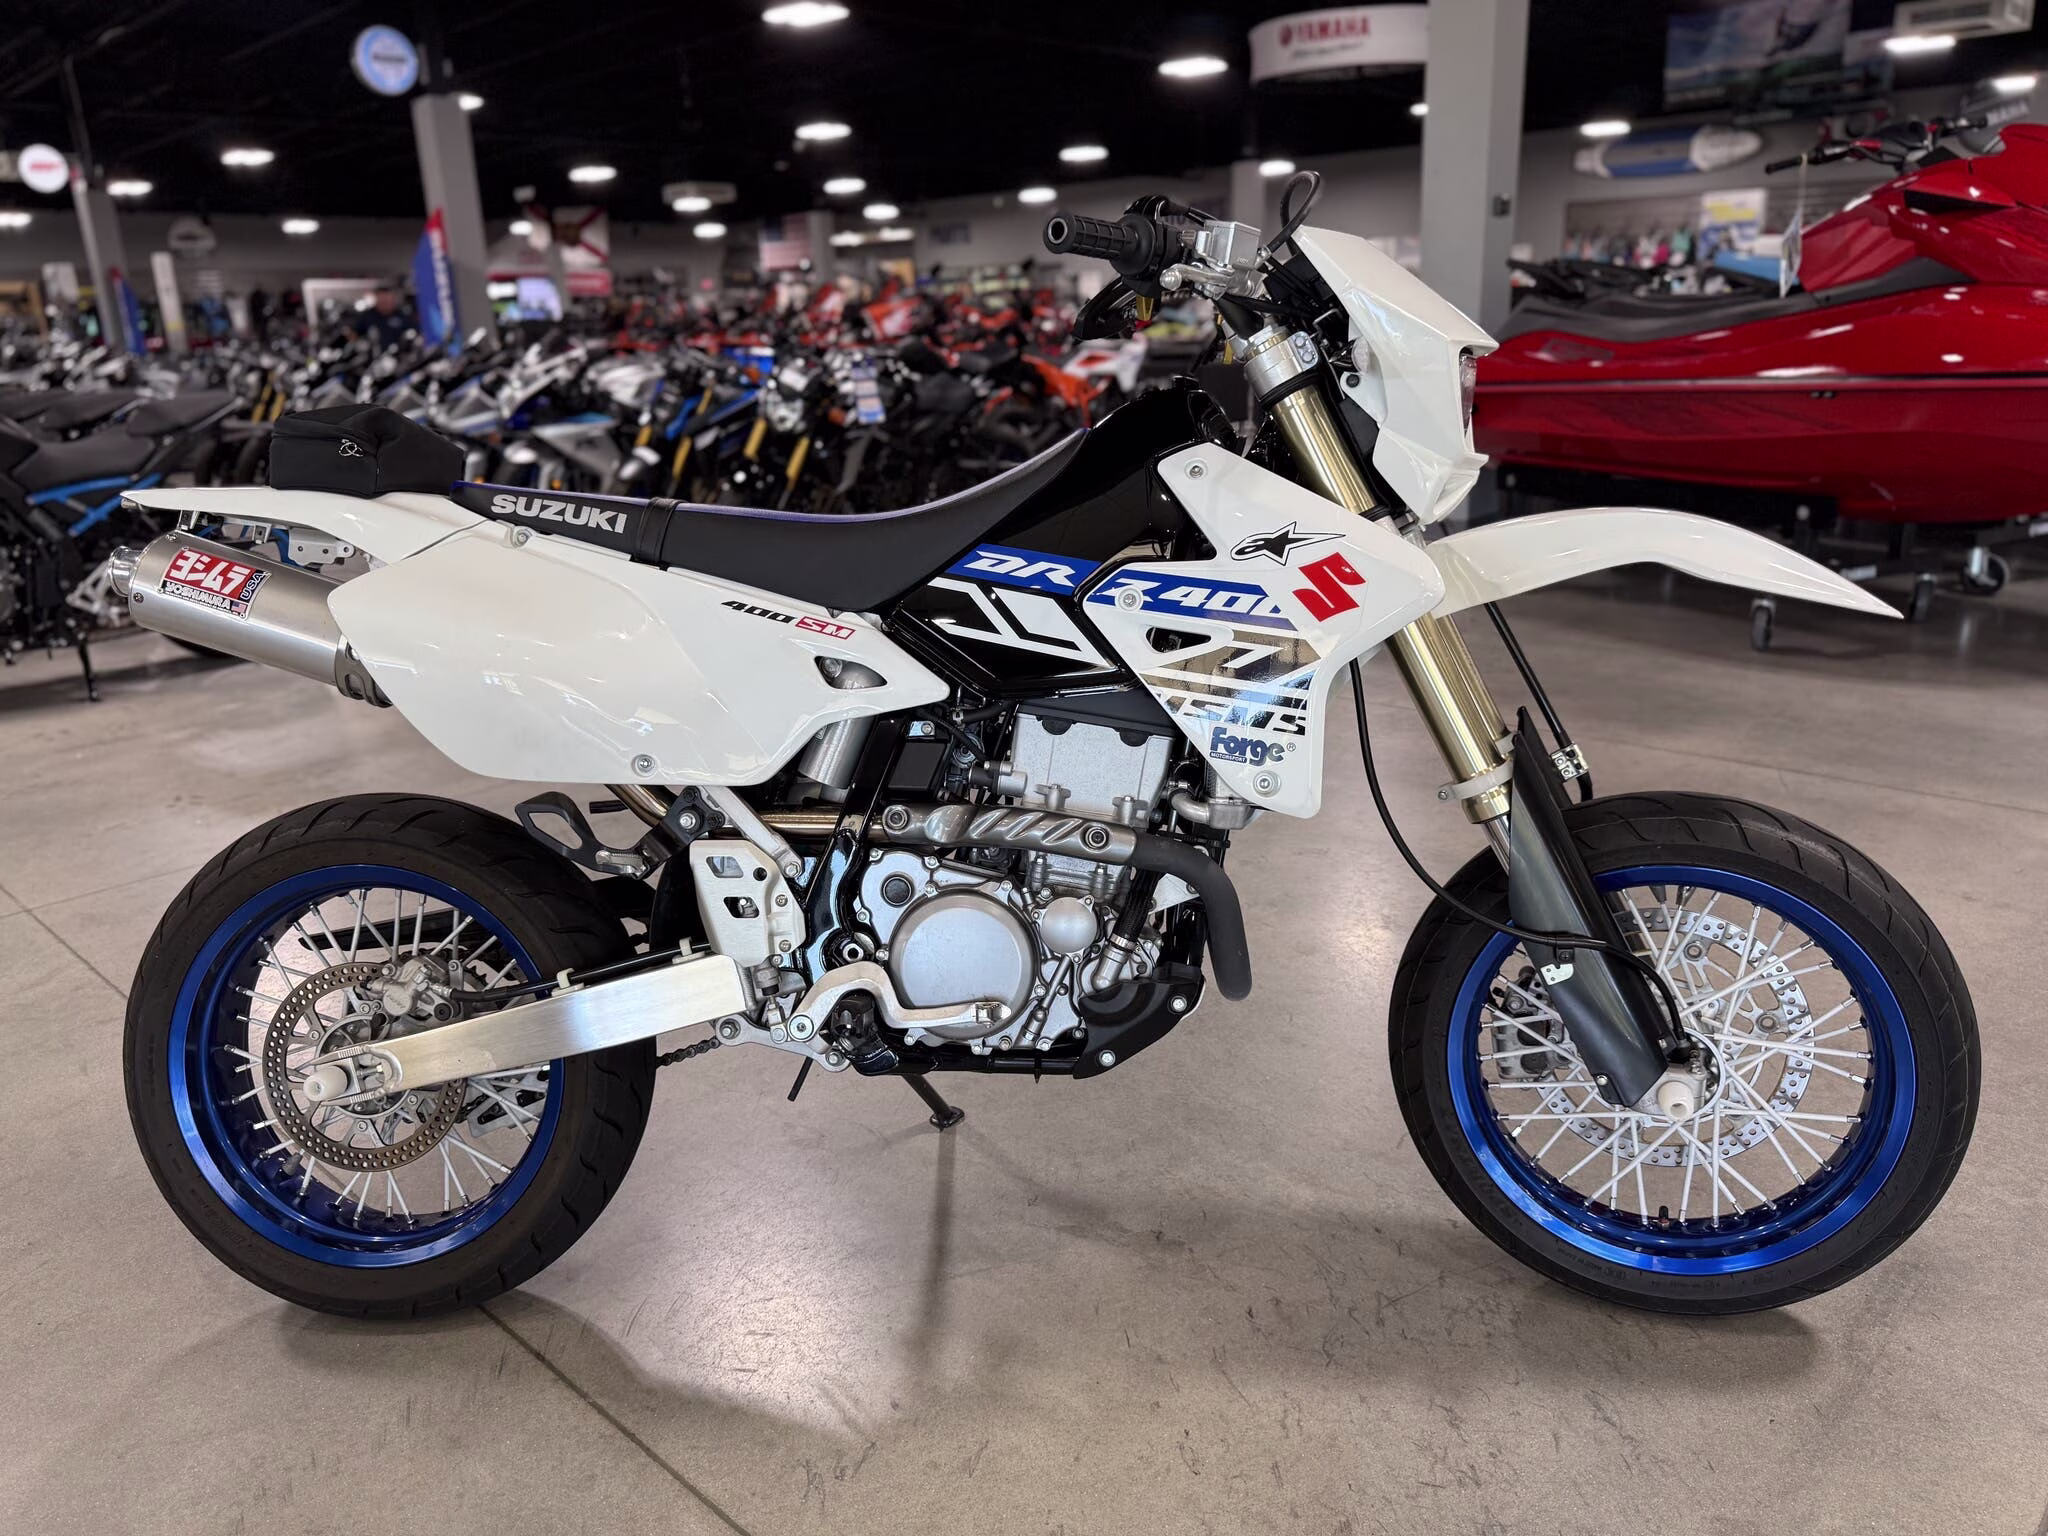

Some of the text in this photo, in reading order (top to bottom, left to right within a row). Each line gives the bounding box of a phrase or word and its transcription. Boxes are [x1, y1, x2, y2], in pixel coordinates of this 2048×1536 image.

[490, 493, 628, 534] SUZUKI
[169, 550, 251, 595] ヨシムラ
[240, 572, 266, 600] USA
[963, 550, 1077, 588] DR
[164, 581, 231, 610] YOSHIMURA
[720, 600, 856, 640] 400 SM
[1209, 726, 1286, 767] Forge
[1209, 751, 1248, 764] MOTORSPORT
